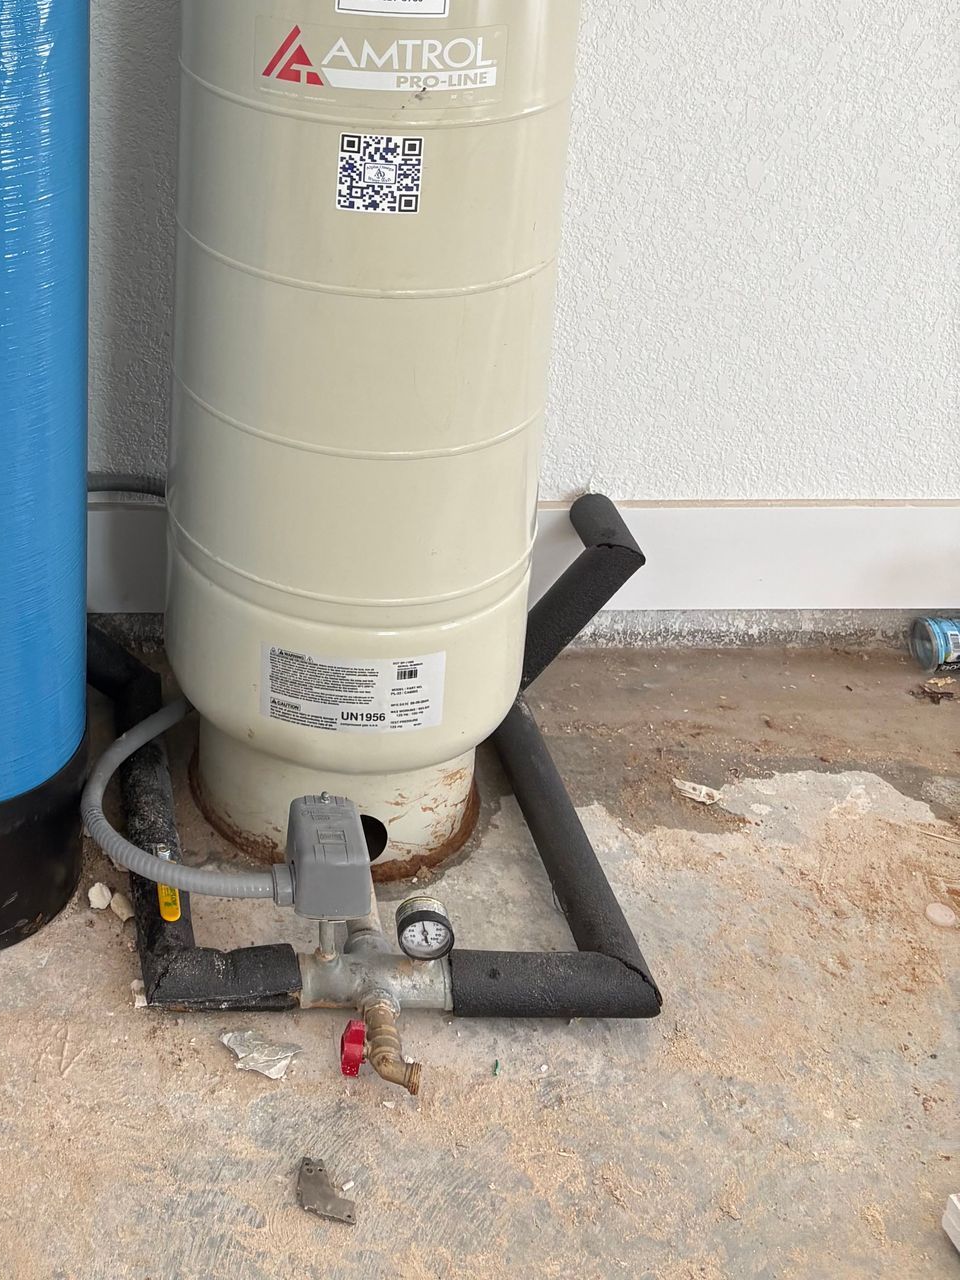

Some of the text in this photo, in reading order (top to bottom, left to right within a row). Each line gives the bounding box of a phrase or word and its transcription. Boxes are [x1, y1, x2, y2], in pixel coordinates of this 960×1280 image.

[322, 37, 494, 69] AMTROL
[396, 73, 487, 88] PRO-LINE
[277, 700, 300, 710] CAUTION
[341, 711, 386, 722] UN1956
